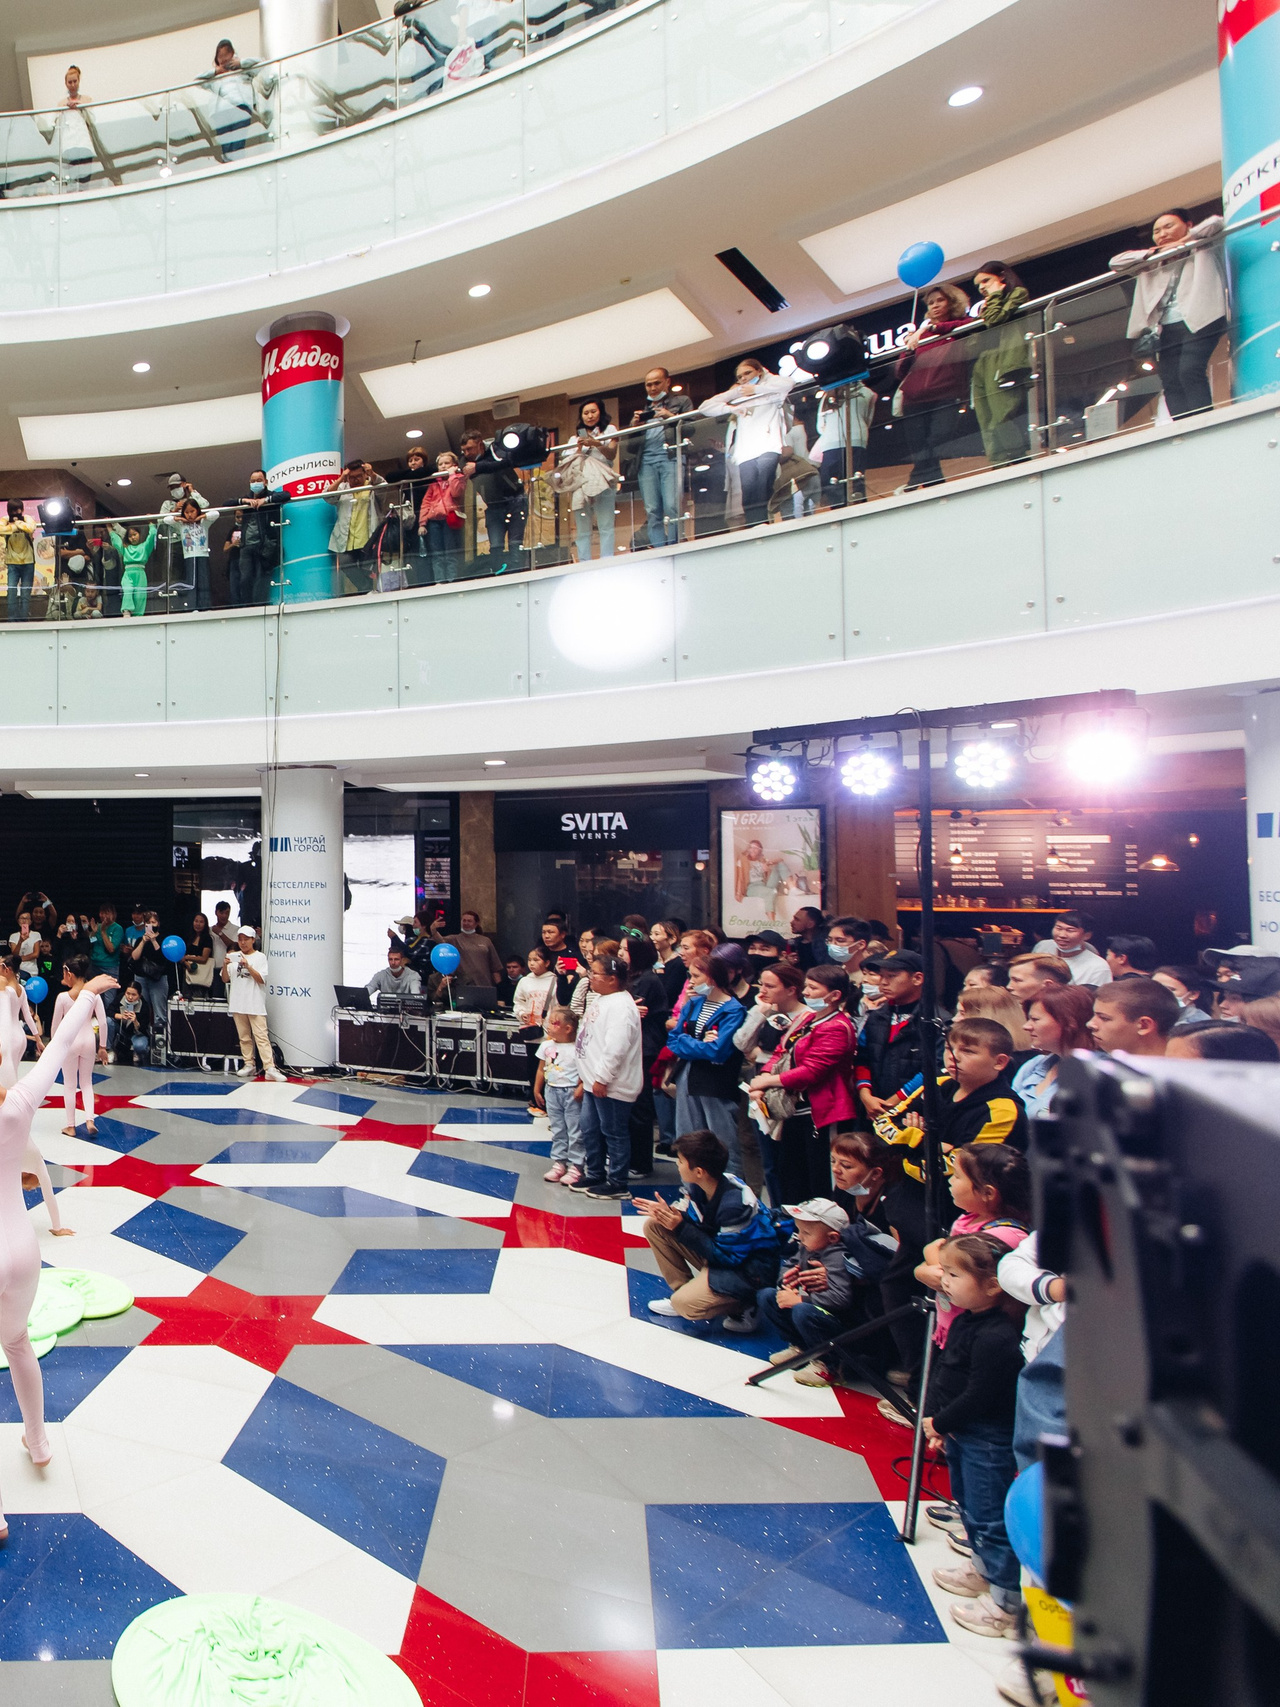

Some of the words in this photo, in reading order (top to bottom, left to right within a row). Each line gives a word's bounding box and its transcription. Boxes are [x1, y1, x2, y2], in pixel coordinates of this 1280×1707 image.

[296, 484, 304, 494] 3
[560, 812, 628, 831] SVITA
[293, 834, 326, 844] ЧИТАЙ
[572, 832, 617, 840] EVENTS
[293, 844, 326, 853] ГОРОД
[269, 932, 326, 941] КАНЦЕЛЯРИЯ
[269, 950, 296, 958] КНИГИ
[276, 985, 312, 997] ЭТАЖ
